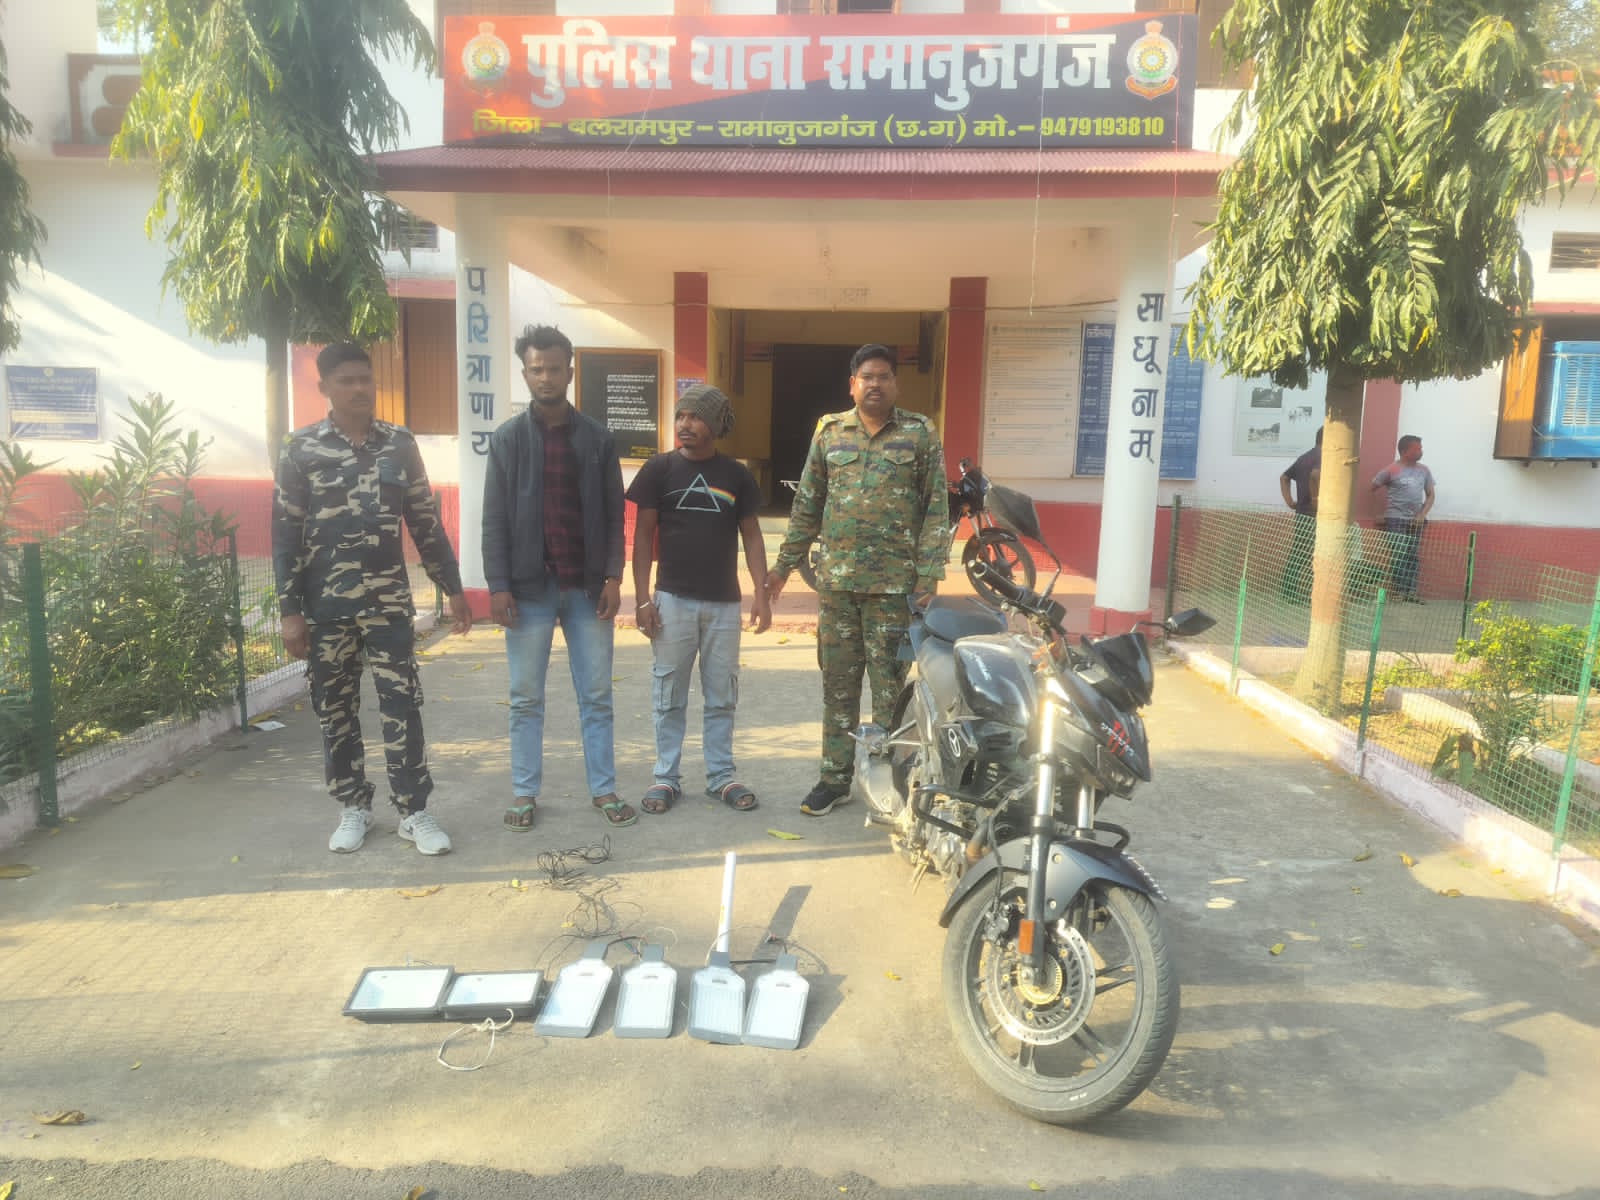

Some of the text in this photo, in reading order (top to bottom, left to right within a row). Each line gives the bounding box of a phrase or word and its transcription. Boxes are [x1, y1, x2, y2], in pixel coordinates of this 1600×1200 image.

[522, 18, 677, 109] पुलिस
[819, 16, 1117, 111] रामानुजगंज
[1040, 116, 1165, 137] 9479193810
